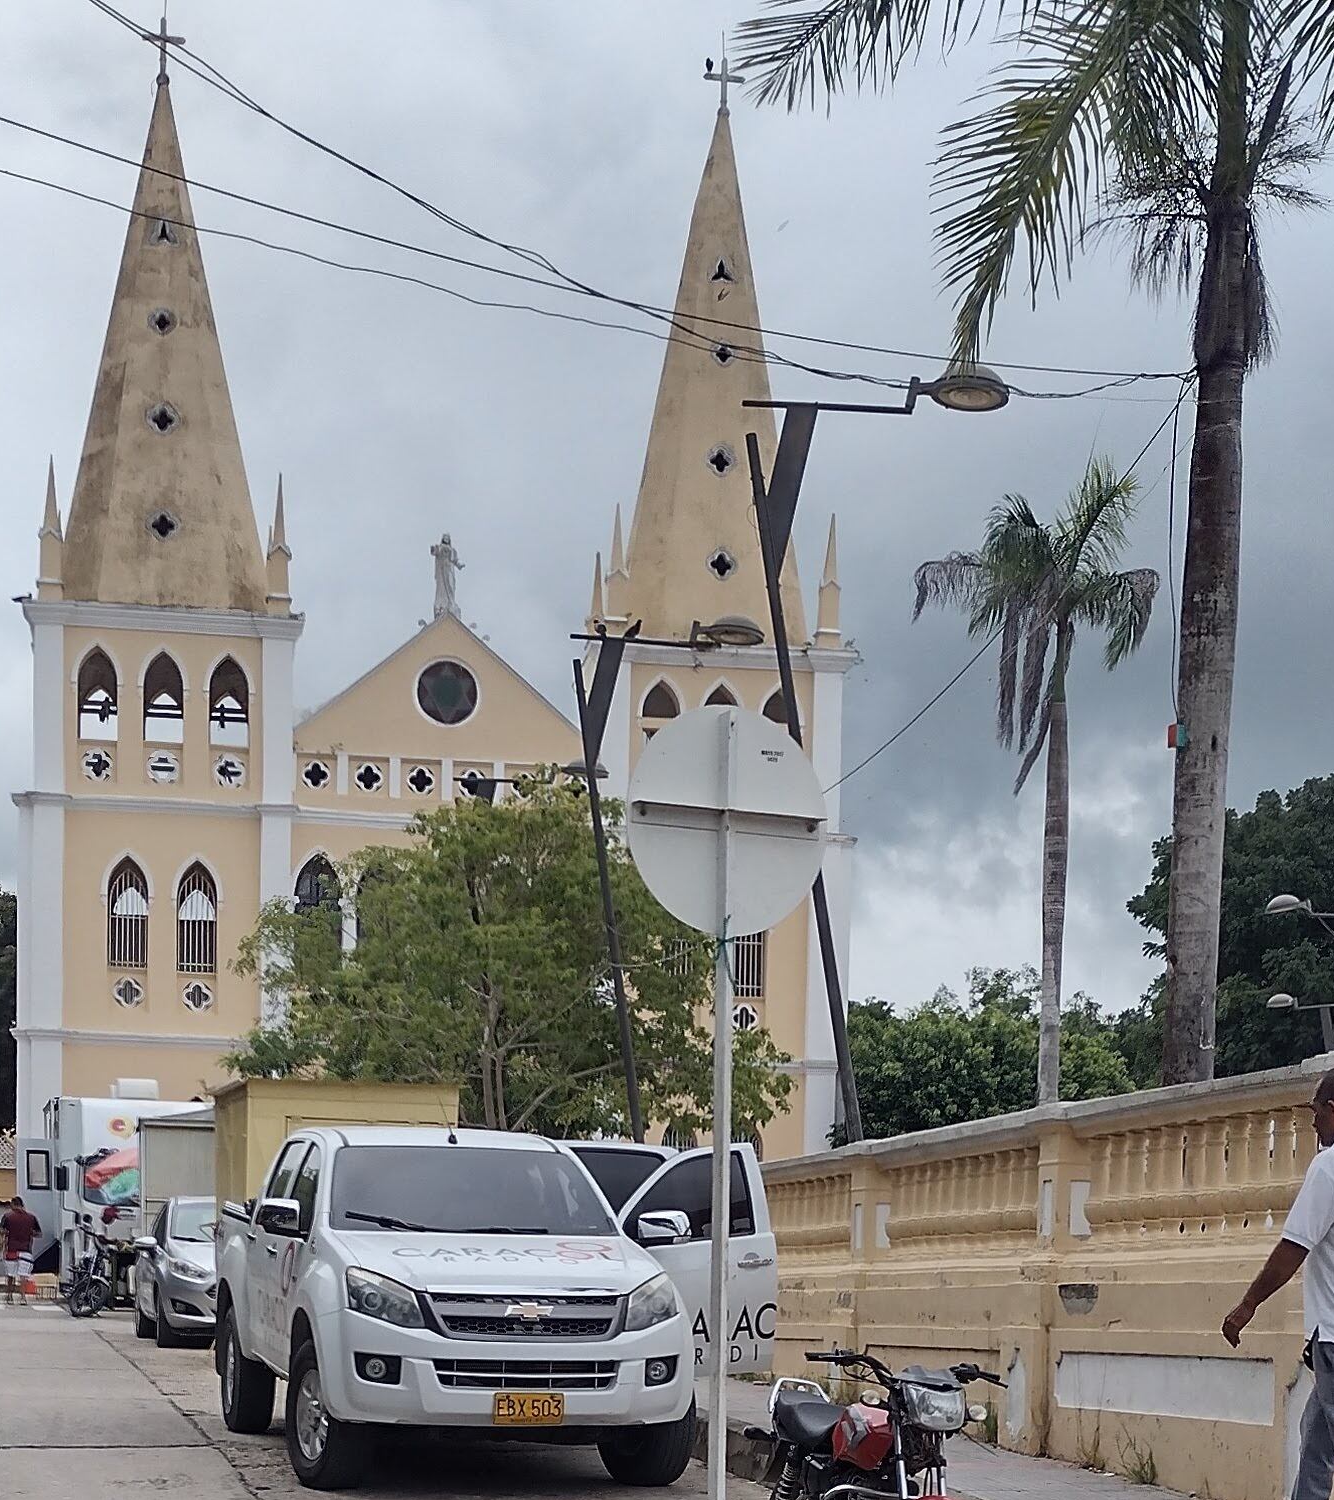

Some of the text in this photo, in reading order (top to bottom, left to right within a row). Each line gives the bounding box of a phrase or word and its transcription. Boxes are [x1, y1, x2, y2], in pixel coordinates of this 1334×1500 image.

[392, 1242, 624, 1262] CARACOL
[443, 1256, 579, 1265] RADIO
[692, 1303, 777, 1343] AAC
[694, 1344, 758, 1365] RDI
[497, 1398, 562, 1417] EBX 503
